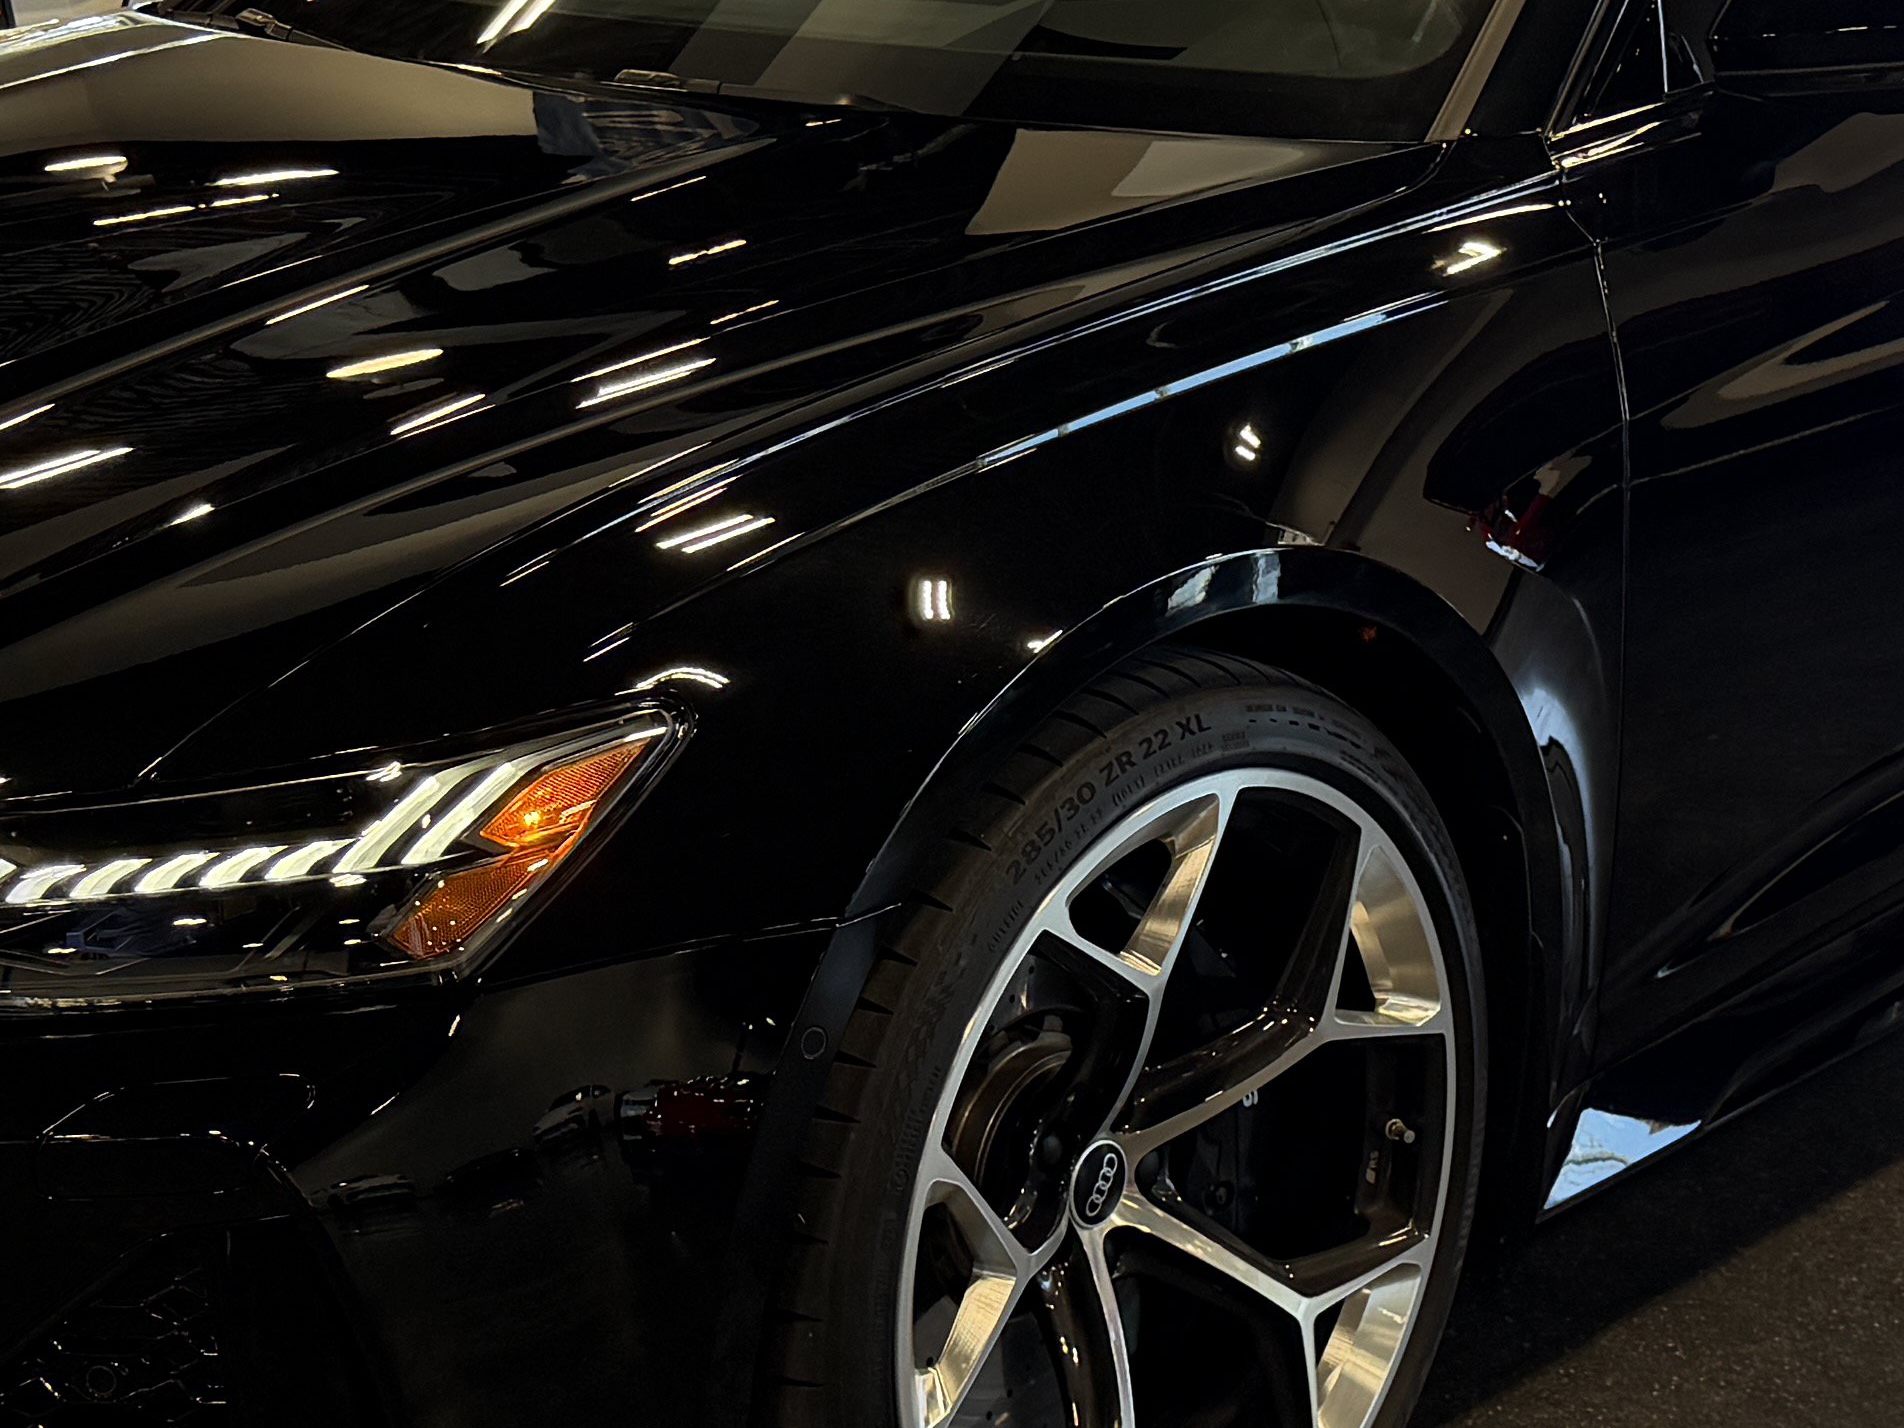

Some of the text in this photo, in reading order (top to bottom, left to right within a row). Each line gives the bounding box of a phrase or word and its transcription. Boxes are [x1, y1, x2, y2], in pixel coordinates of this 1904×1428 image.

[1005, 782, 1098, 886] 285/30
[1097, 749, 1139, 789] ZR
[1137, 728, 1173, 762] 22
[1175, 712, 1213, 742] XL
